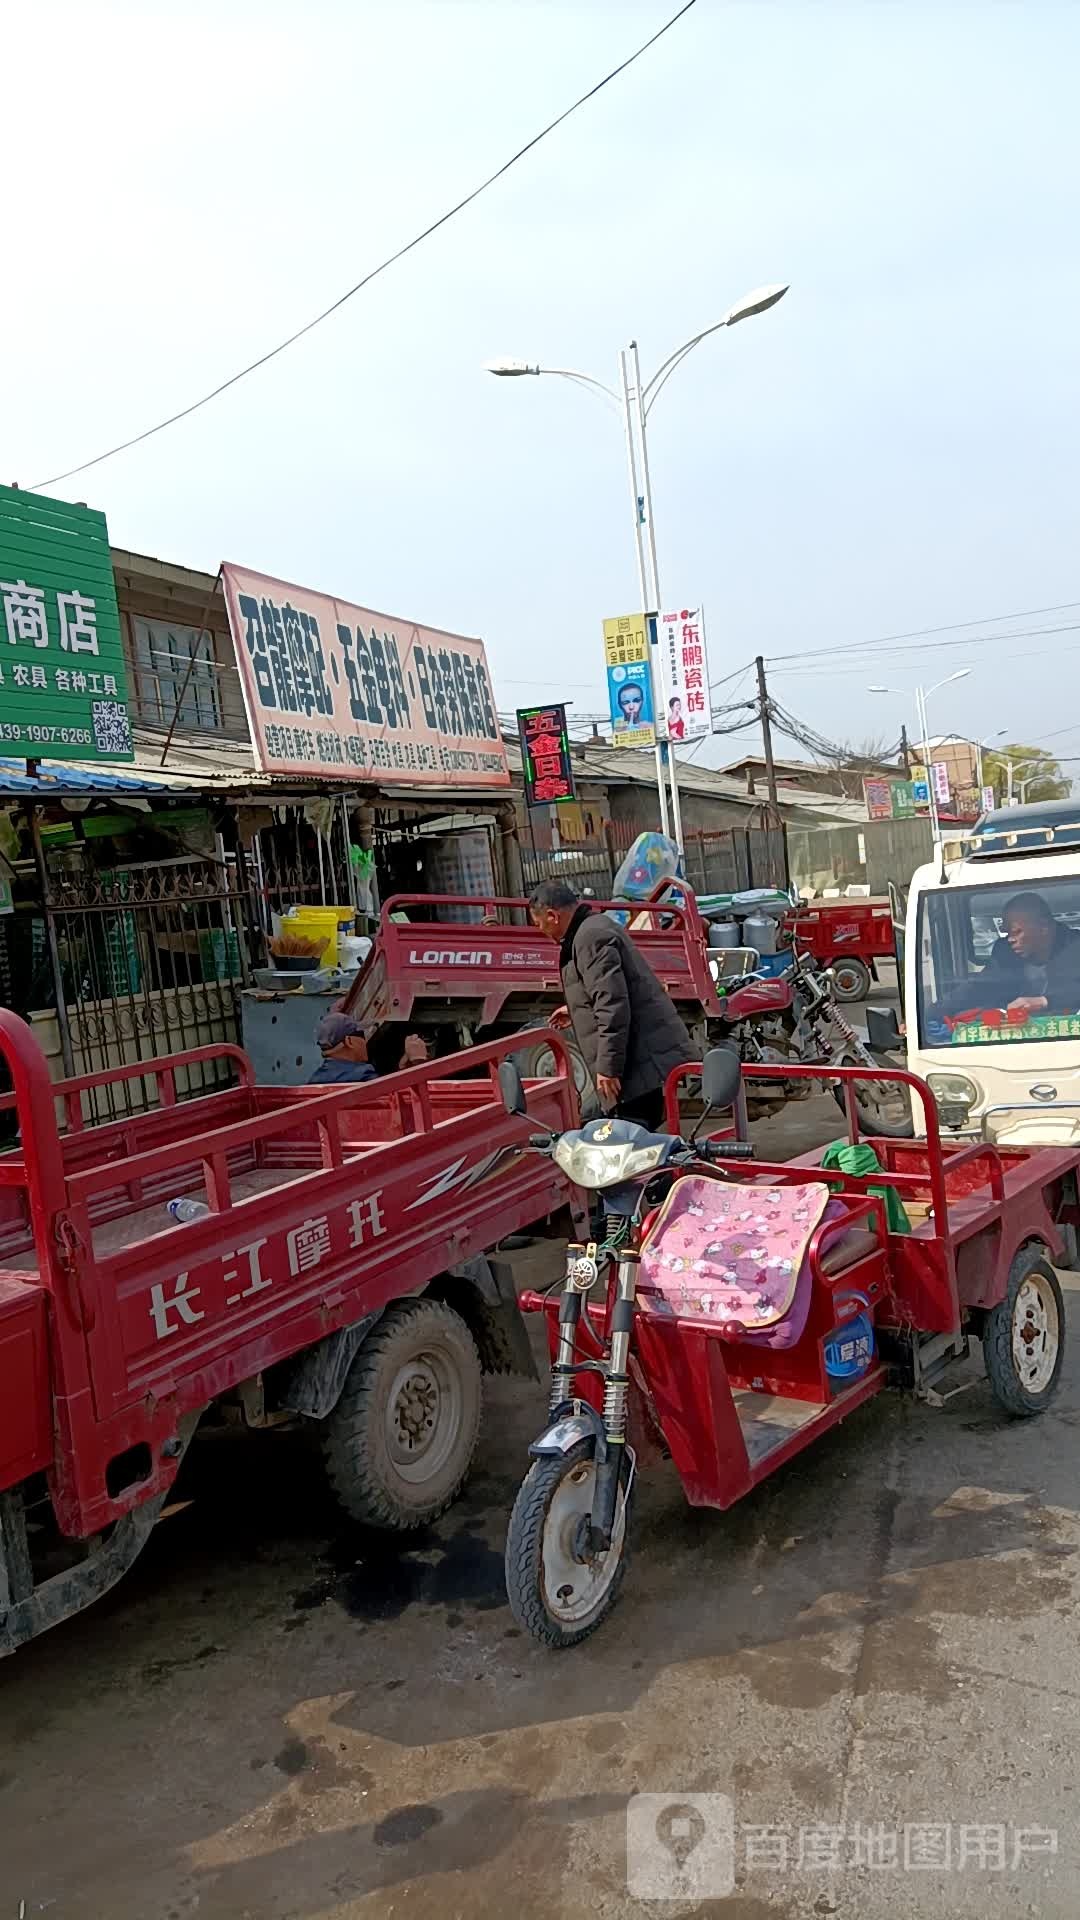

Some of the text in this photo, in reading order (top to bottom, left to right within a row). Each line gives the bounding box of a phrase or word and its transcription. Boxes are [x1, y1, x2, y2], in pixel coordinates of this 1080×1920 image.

[0, 579, 99, 656] 商店
[13, 664, 47, 689] 农具
[55, 668, 118, 696] 各种工具
[682, 623, 705, 713] 东鹏瓷砖
[148, 1190, 388, 1340] 长江摩托
